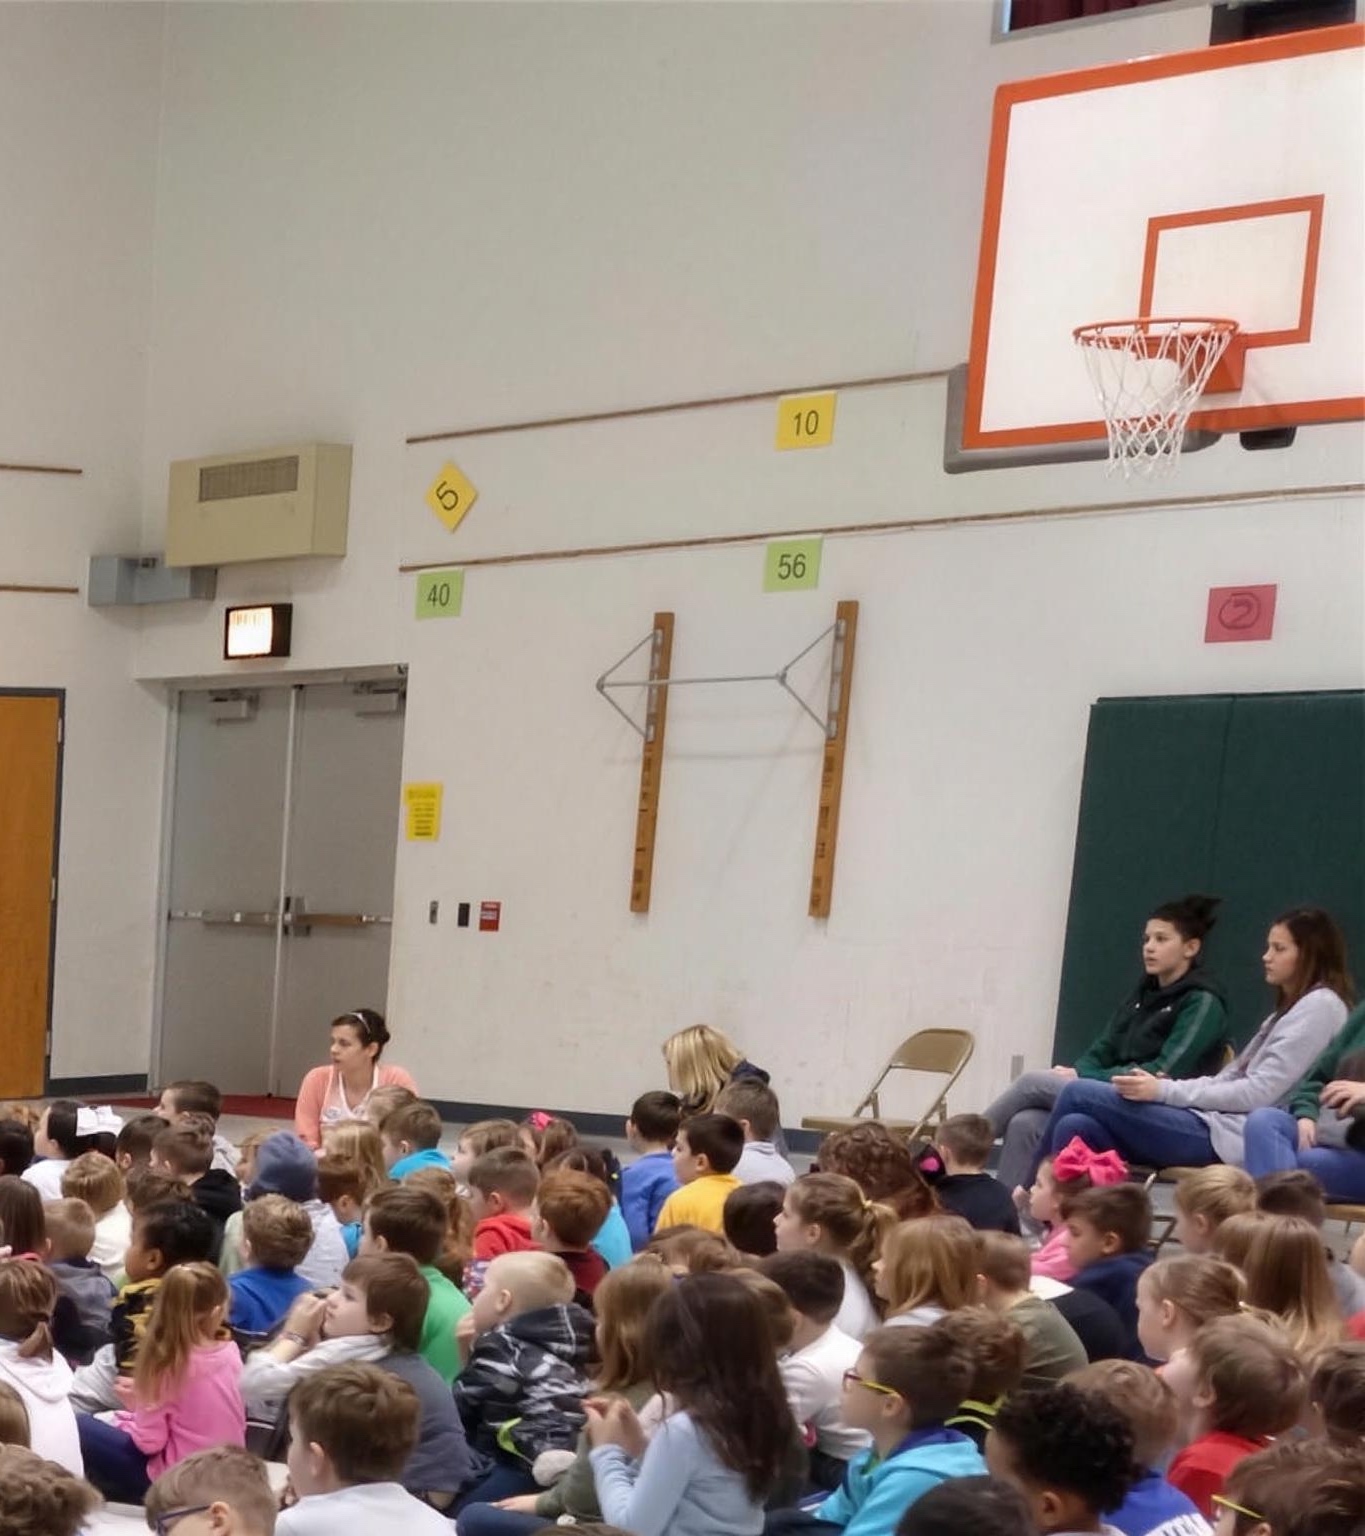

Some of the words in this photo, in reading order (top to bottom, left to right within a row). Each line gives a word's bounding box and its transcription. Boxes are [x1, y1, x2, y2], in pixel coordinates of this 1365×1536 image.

[793, 409, 820, 437] 10
[435, 480, 460, 512] 5
[777, 552, 807, 581] 56
[426, 582, 451, 608] 40
